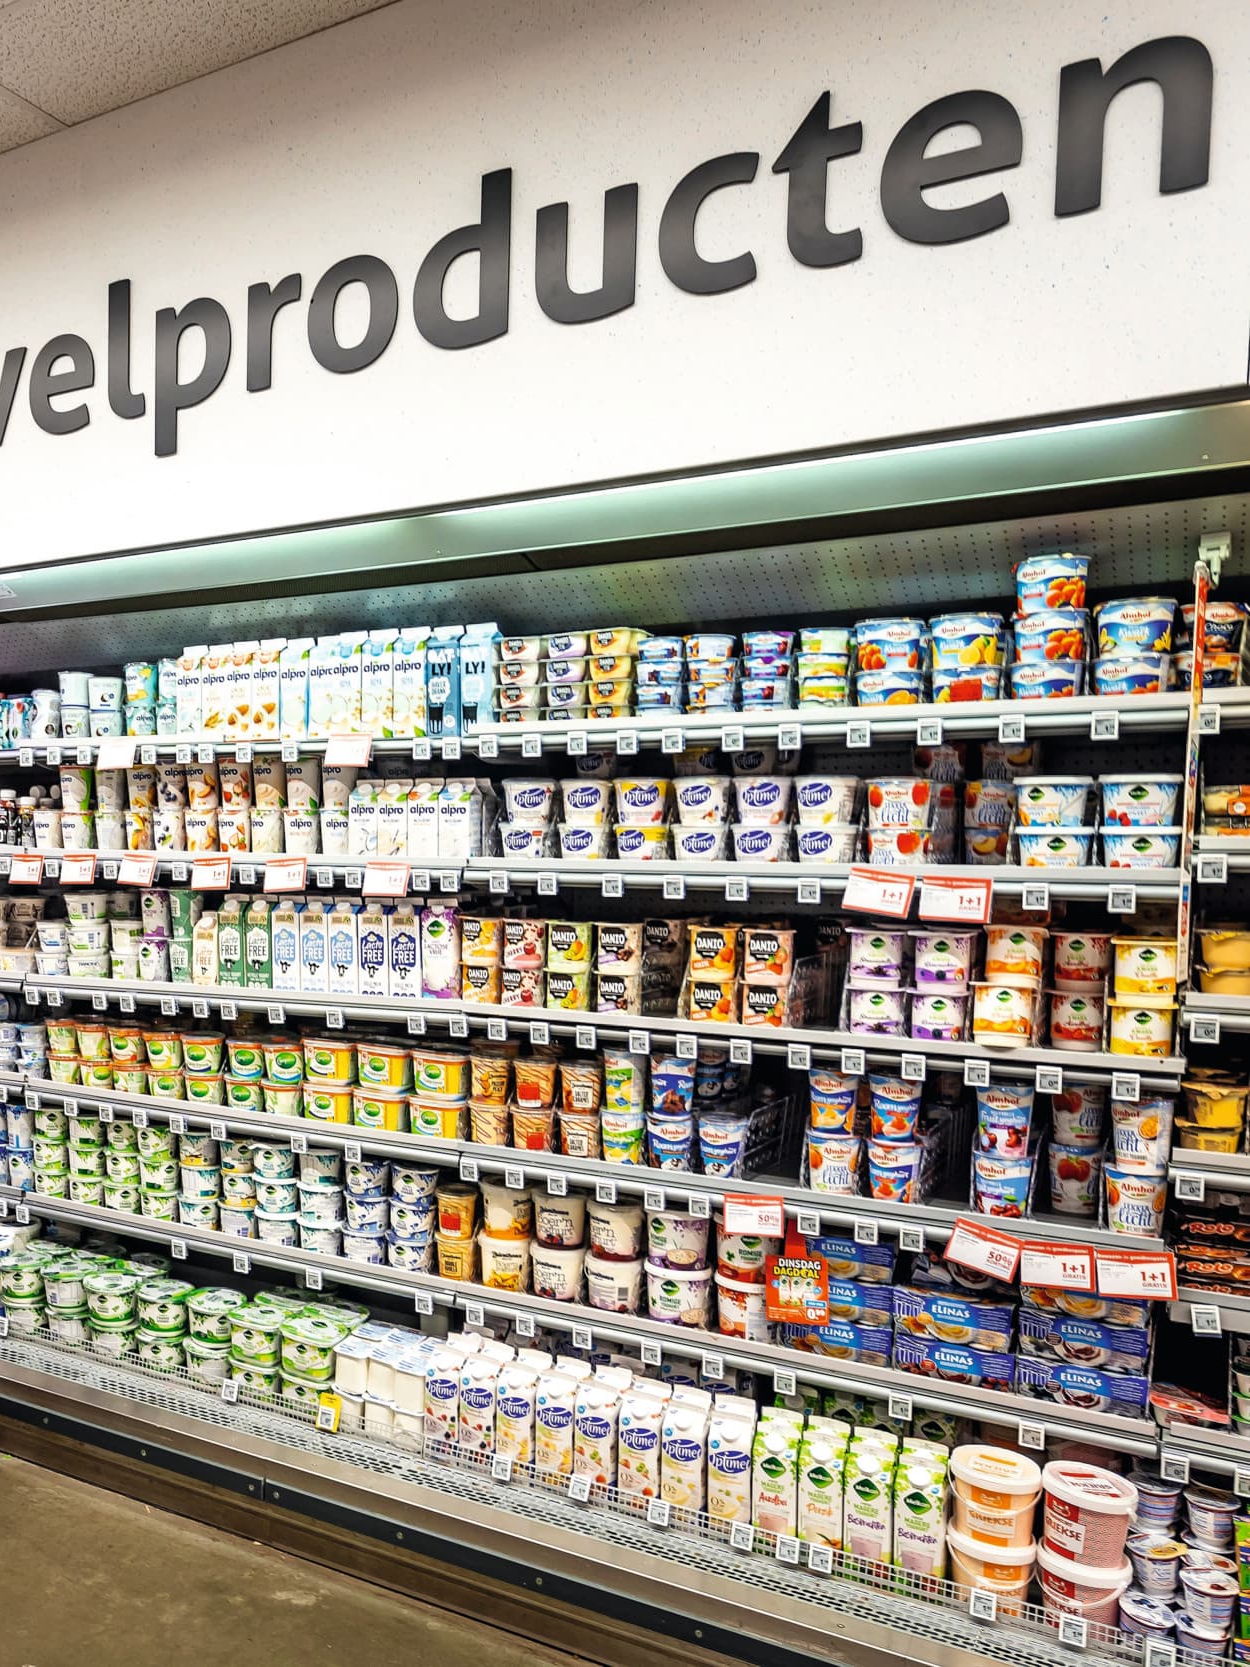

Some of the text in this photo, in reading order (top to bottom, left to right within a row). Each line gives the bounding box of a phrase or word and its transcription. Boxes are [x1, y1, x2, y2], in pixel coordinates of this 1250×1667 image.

[334, 664, 358, 676] alpro
[364, 662, 390, 675] alpro
[395, 661, 421, 673] alpro
[465, 662, 485, 674] LY!
[203, 675, 225, 685] alpro
[227, 672, 250, 683] alpro
[254, 669, 277, 681] alpro
[282, 669, 306, 681] alpro
[177, 677, 199, 687] alpro
[351, 805, 374, 817] alpro
[380, 806, 403, 817] alpro
[410, 805, 435, 817] alpro
[441, 805, 466, 817] alpro
[290, 820, 312, 829] alpro
[326, 820, 348, 829] alpro
[882, 889, 902, 900] 1+1
[959, 896, 981, 906] 1+1
[463, 922, 479, 930] DANIO
[506, 925, 522, 934] DANIO
[552, 931, 576, 943] DANIO
[601, 933, 625, 944] DANIO
[697, 938, 724, 949] DANIO
[750, 940, 778, 951] DANIO
[221, 945, 239, 956] FREE
[249, 946, 267, 956] FREE
[362, 951, 383, 962] FREE
[393, 951, 415, 963] FREE
[469, 969, 487, 978] DANIO
[503, 972, 520, 980] DANIO
[550, 978, 573, 990] DANIO
[601, 982, 624, 993] DANIO
[695, 989, 721, 1000] DANIO
[749, 993, 777, 1004] DANIO
[882, 1087, 913, 1095] Almhof
[987, 1094, 1019, 1105] Almhof
[660, 1128, 686, 1136] Almhof
[1121, 1183, 1155, 1193] Almhof
[1190, 1223, 1234, 1235] Rolo
[822, 1243, 856, 1254] ELINAS
[779, 1258, 821, 1270] DINSDAG
[988, 1251, 1012, 1267] 50%
[1062, 1263, 1086, 1274] 1+1
[1187, 1262, 1233, 1273] Rolo
[1140, 1271, 1166, 1282] 1+1
[829, 1286, 857, 1297] LINAS
[932, 1304, 970, 1319] ELINAS
[819, 1327, 854, 1339] ELINAS
[1061, 1324, 1102, 1339] ELINAS
[935, 1351, 973, 1365] ELINAS
[1060, 1372, 1102, 1386] ELINAS
